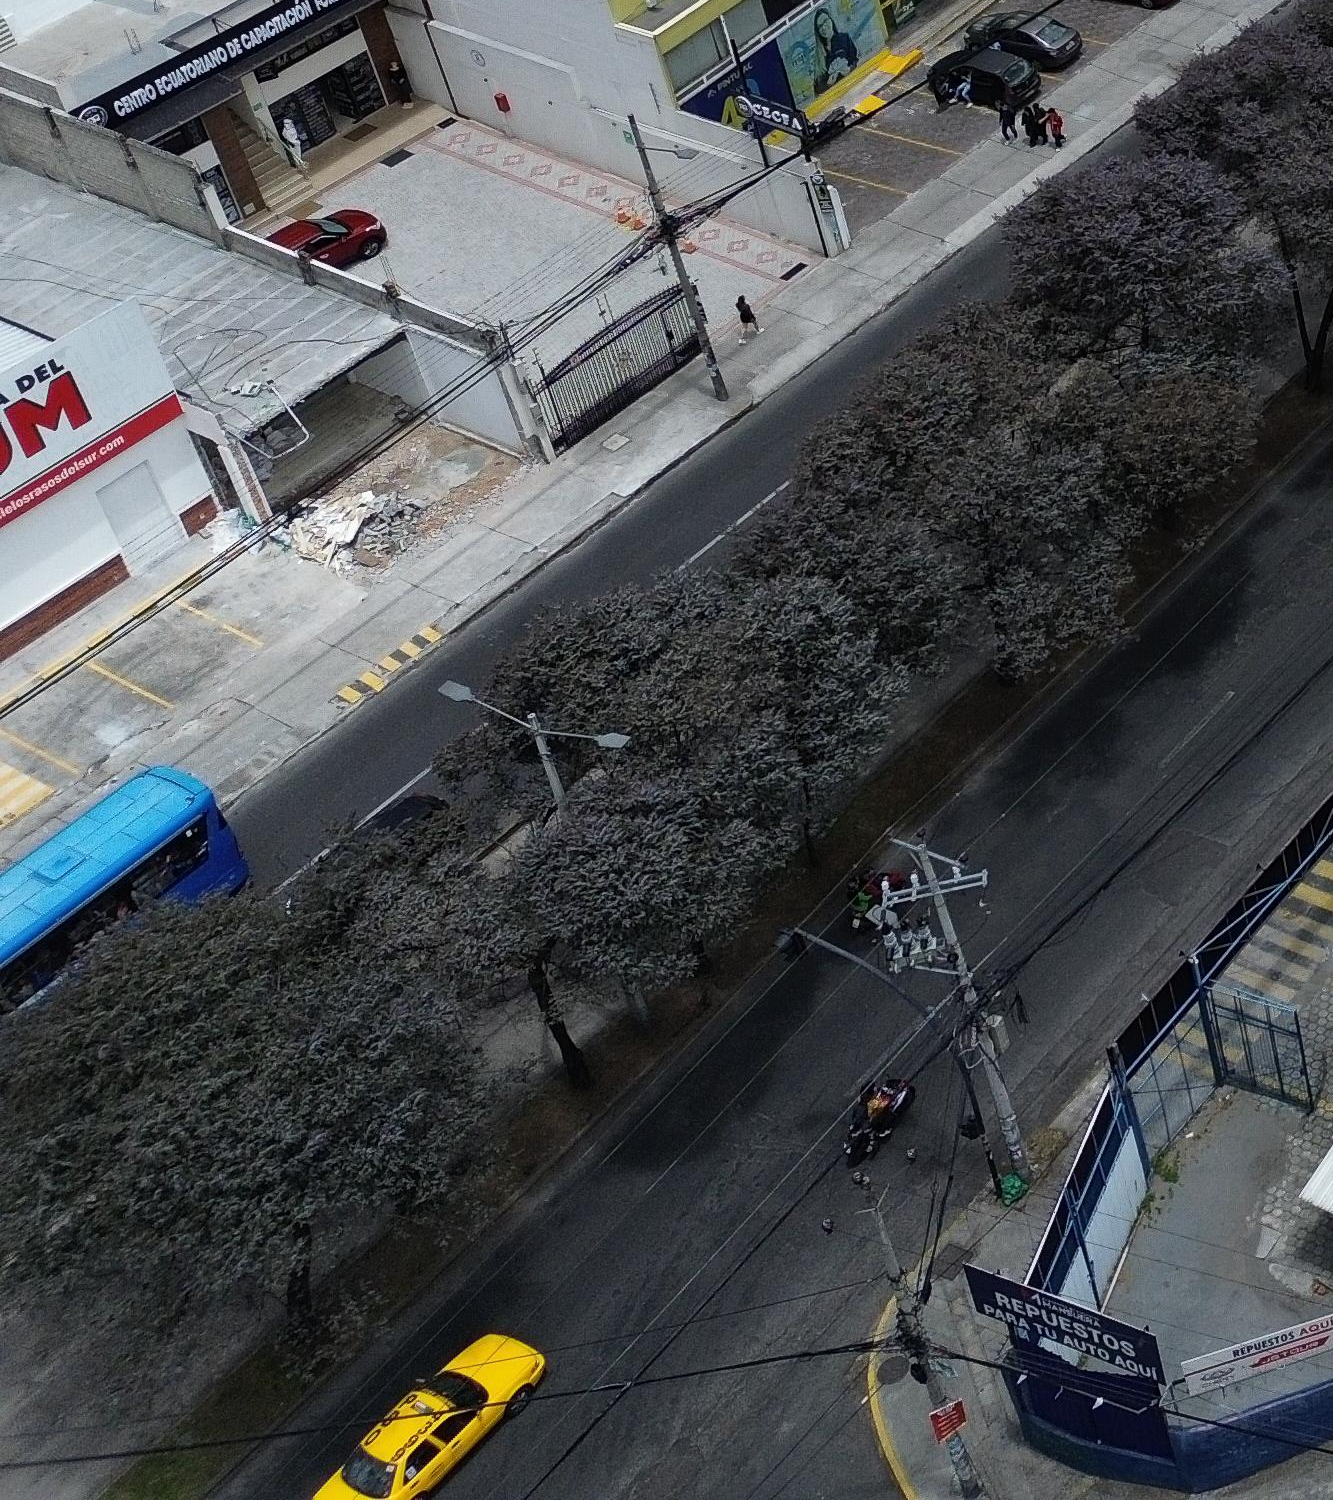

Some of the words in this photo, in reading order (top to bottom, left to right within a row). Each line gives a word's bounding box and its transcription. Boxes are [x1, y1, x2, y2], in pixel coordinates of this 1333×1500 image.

[113, 83, 157, 117] CENTRO
[155, 46, 228, 96] ECUATORIANO
[226, 37, 243, 59] DE
[717, 63, 753, 91] PINTUAC
[15, 358, 65, 394] DEL
[983, 1303, 1031, 1331] PARA
[1033, 1322, 1058, 1340] TU
[1063, 1335, 1110, 1362] AUTO
[994, 1291, 1137, 1358] REPUESTOS
[1232, 1331, 1295, 1359] REPUESTOS
